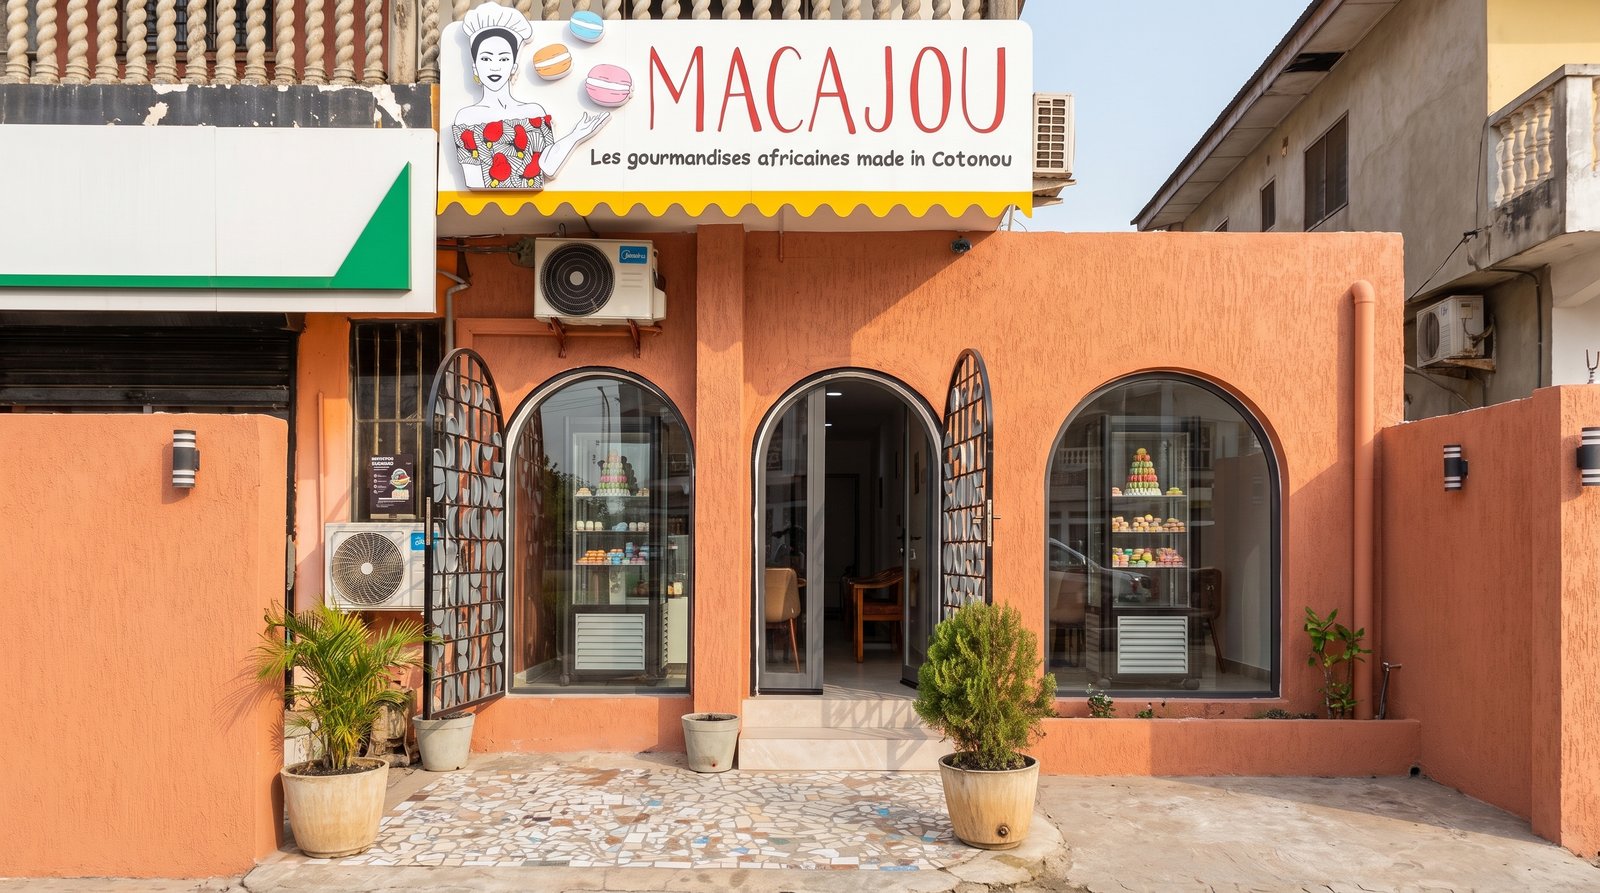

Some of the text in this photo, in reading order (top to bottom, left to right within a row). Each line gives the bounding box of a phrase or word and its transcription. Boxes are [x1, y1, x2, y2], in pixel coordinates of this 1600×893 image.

[650, 46, 1007, 135] MACAJOU
[591, 149, 1012, 170] Les gourmandises africaines made in Cotonou
